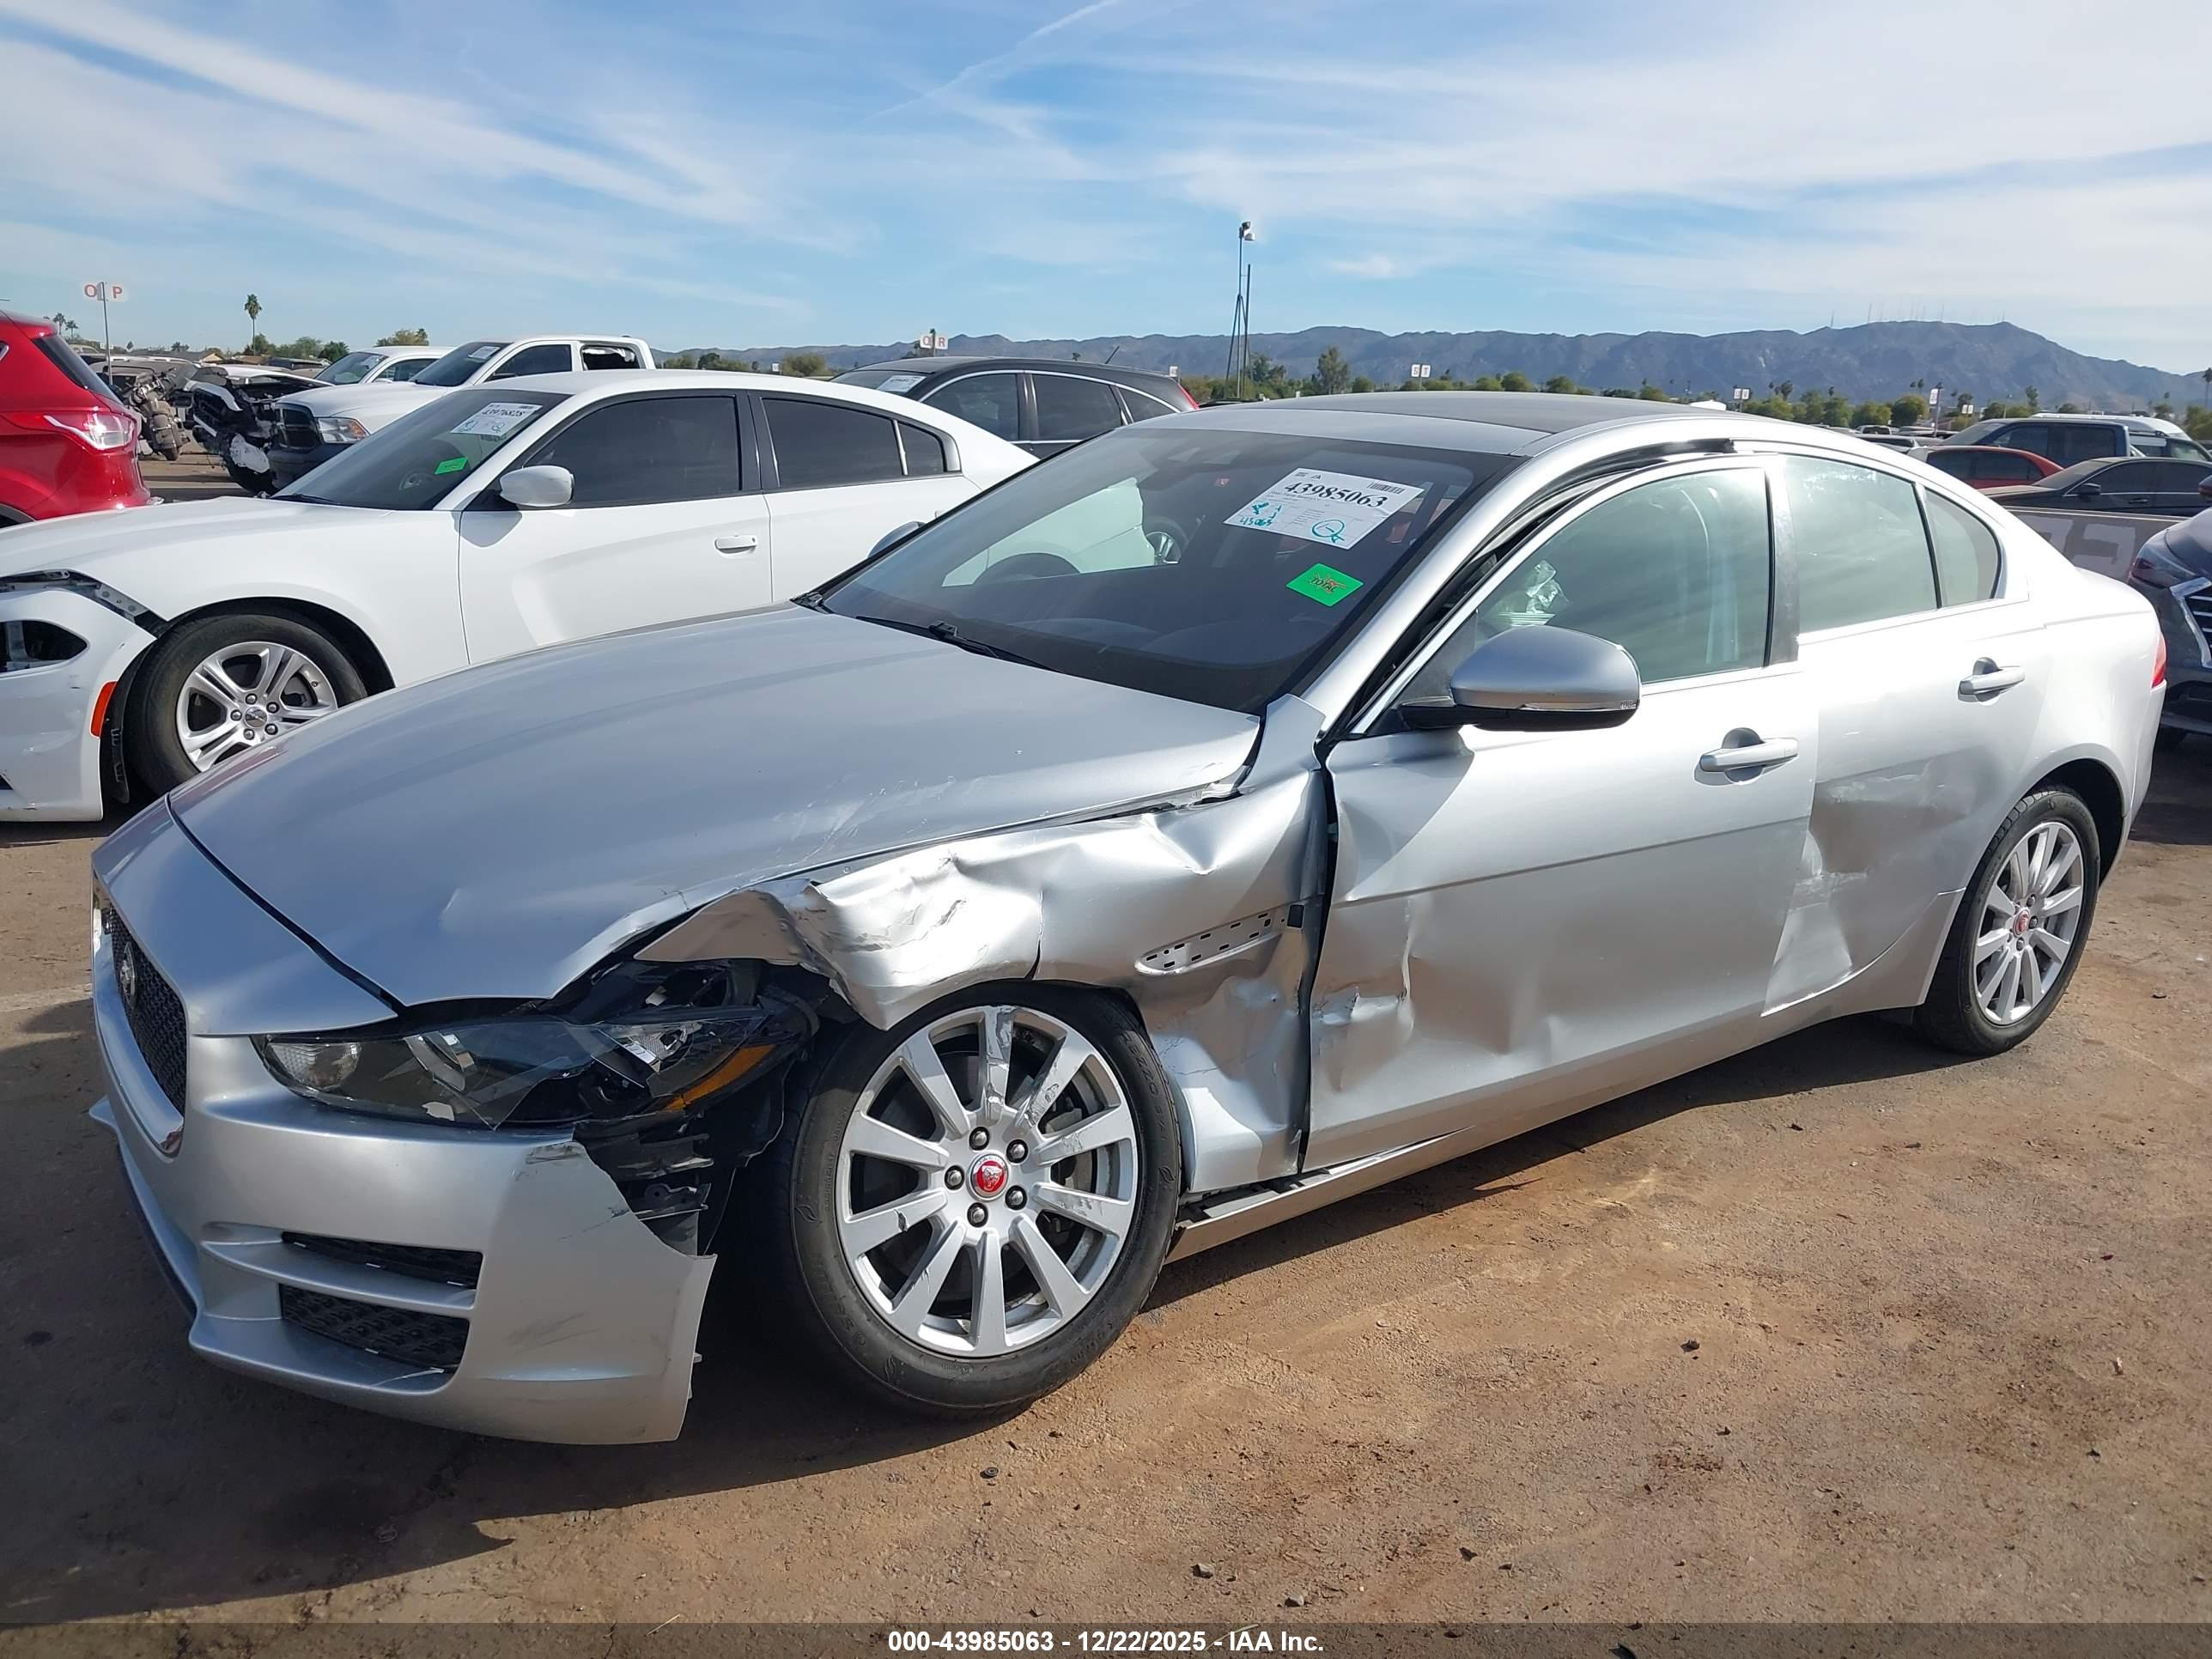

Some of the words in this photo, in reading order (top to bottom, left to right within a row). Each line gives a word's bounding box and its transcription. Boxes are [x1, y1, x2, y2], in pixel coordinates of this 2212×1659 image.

[84, 284, 97, 297] O
[112, 286, 123, 299] P
[939, 337, 945, 347] R
[1284, 481, 1389, 508] 43985063
